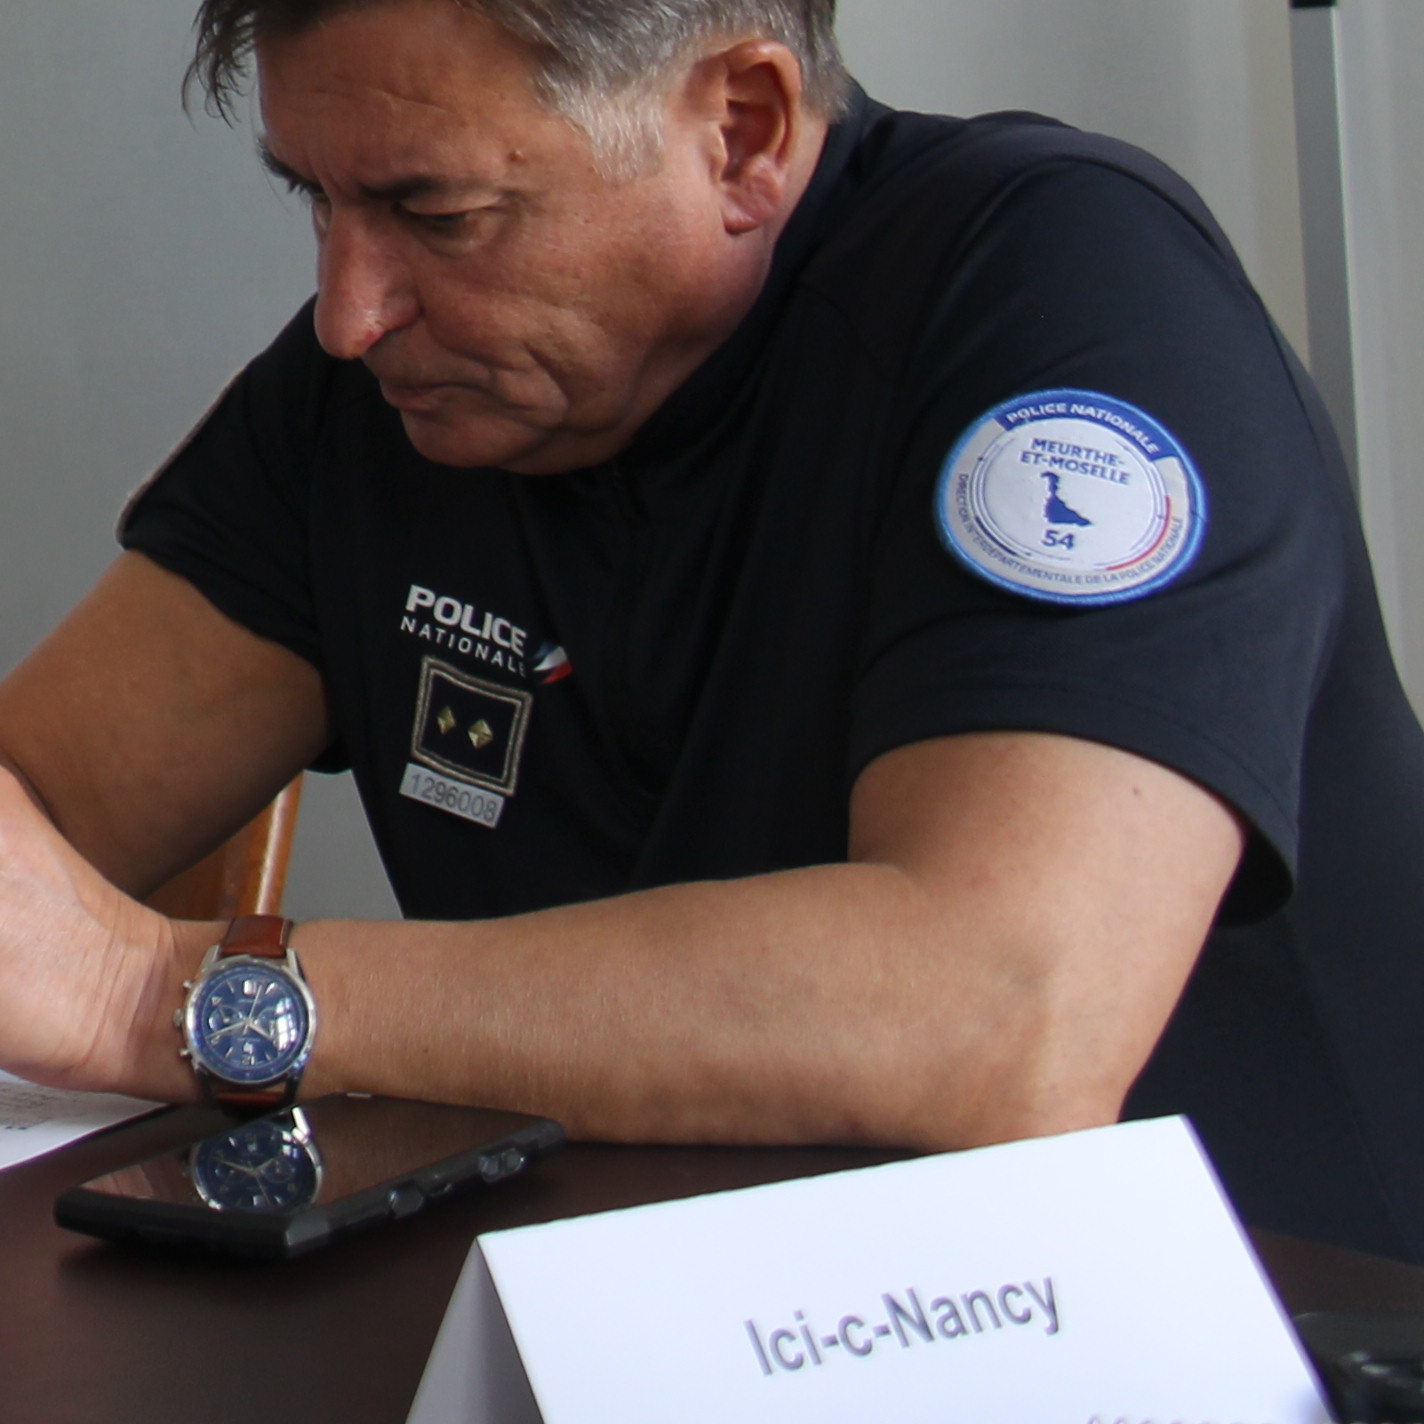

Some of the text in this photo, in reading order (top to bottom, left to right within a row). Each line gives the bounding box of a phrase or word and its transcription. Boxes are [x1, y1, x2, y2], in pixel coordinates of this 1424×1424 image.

[1006, 402, 1160, 454] POLICE NATIONALE
[1030, 438, 1126, 467] MEURTHE-
[1020, 451, 1131, 485] ET-MOSELLE
[957, 473, 971, 524] DIRECTION
[1084, 574, 1101, 585] DE
[1103, 572, 1120, 583] LA
[1042, 529, 1075, 550] 54
[405, 584, 528, 658] POLICE
[401, 616, 526, 679] NATIONALE
[411, 774, 497, 823] 1296008
[744, 1276, 1060, 1376] Ici-c-Nancy
